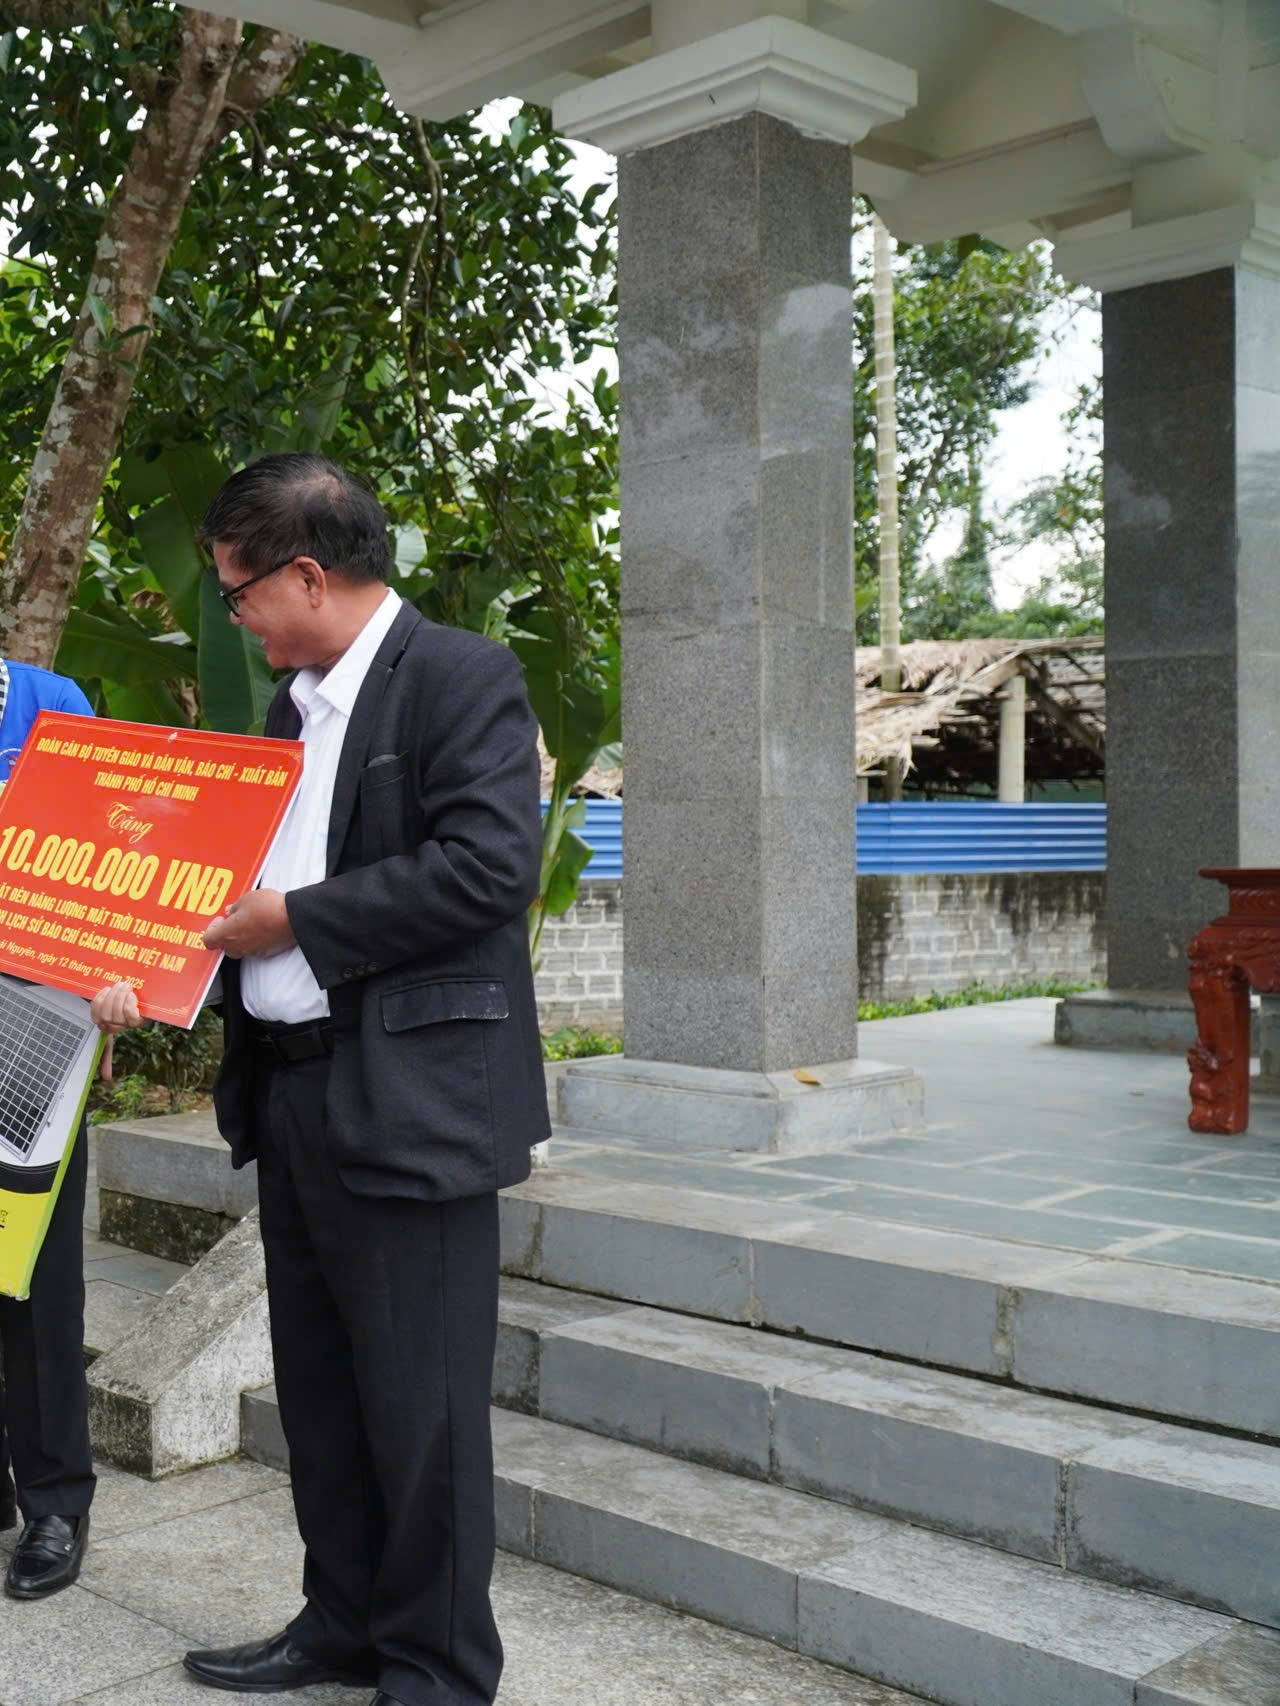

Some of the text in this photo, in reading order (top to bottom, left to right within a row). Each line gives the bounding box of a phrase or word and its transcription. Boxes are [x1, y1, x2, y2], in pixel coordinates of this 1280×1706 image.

[36, 737, 62, 754] ĐOÀN
[60, 740, 81, 757] CÁN
[78, 743, 93, 762] BỘ
[91, 746, 121, 763] TUYÊN
[118, 749, 142, 767] GIÁO
[140, 752, 155, 768] VÀ
[152, 754, 175, 772] DÂN
[195, 760, 217, 778] BÁO
[216, 762, 237, 780] CHÍ
[238, 763, 267, 784] XUẤT
[264, 766, 288, 787] BẢN
[94, 770, 200, 801] THÀNH PHỐ HỒ CHÍ MINH
[106, 801, 154, 844] Tặng
[158, 859, 233, 916] VNĐ
[9, 886, 30, 905] ĐÈN
[28, 892, 57, 912] NĂNG
[54, 899, 88, 919] LƯỢNG
[86, 907, 111, 927] MẶT
[108, 912, 134, 932] TRỜI
[132, 918, 151, 938] TẠI
[149, 923, 187, 944] KHUÔN
[5, 913, 29, 930] LỊCH
[26, 915, 45, 934] SỬ
[40, 921, 62, 939] BÁO
[61, 927, 82, 945] CHÍ
[78, 931, 108, 952] CÁCH
[105, 938, 138, 959] MẠNG
[137, 947, 162, 968] VIỆT
[159, 953, 187, 974] NAM
[6, 942, 36, 959] Nguyên,
[37, 952, 58, 966] ngày
[58, 955, 70, 968] 12
[68, 959, 92, 977] tháng
[92, 966, 104, 977] 11
